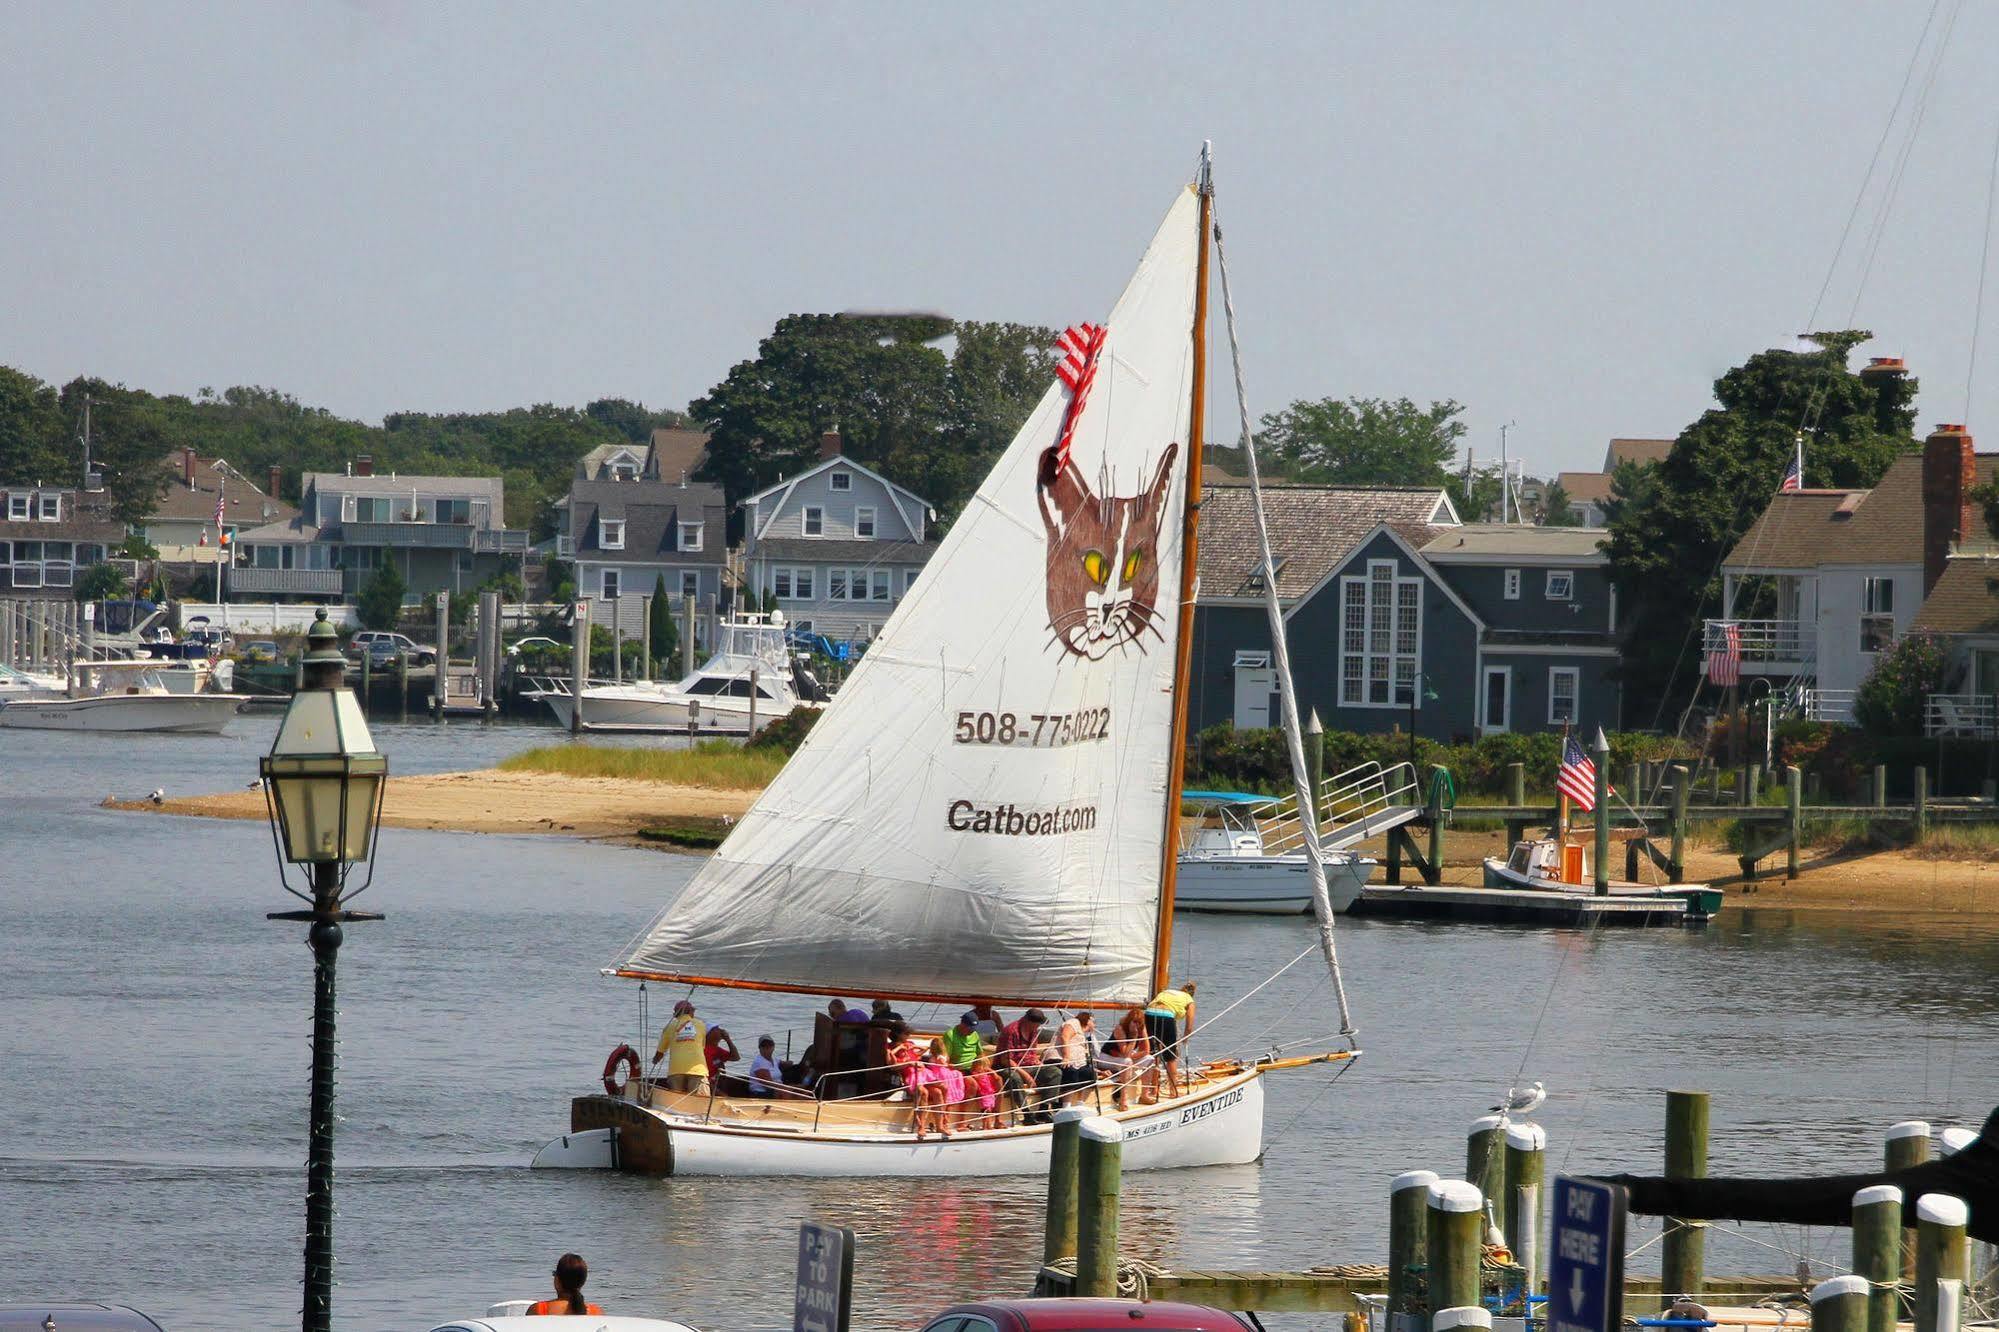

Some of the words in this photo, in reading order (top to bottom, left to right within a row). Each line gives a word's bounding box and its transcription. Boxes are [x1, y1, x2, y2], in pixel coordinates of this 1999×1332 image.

[948, 800, 1096, 836] Catboat.com
[1181, 1087, 1244, 1124] EVENTIDE
[1126, 1128, 1140, 1139] MS
[1567, 1187, 1595, 1222] PAY
[805, 1232, 833, 1256] PAY
[1559, 1227, 1600, 1265] HERE
[809, 1260, 828, 1283] TO
[798, 1284, 834, 1313] PARK
